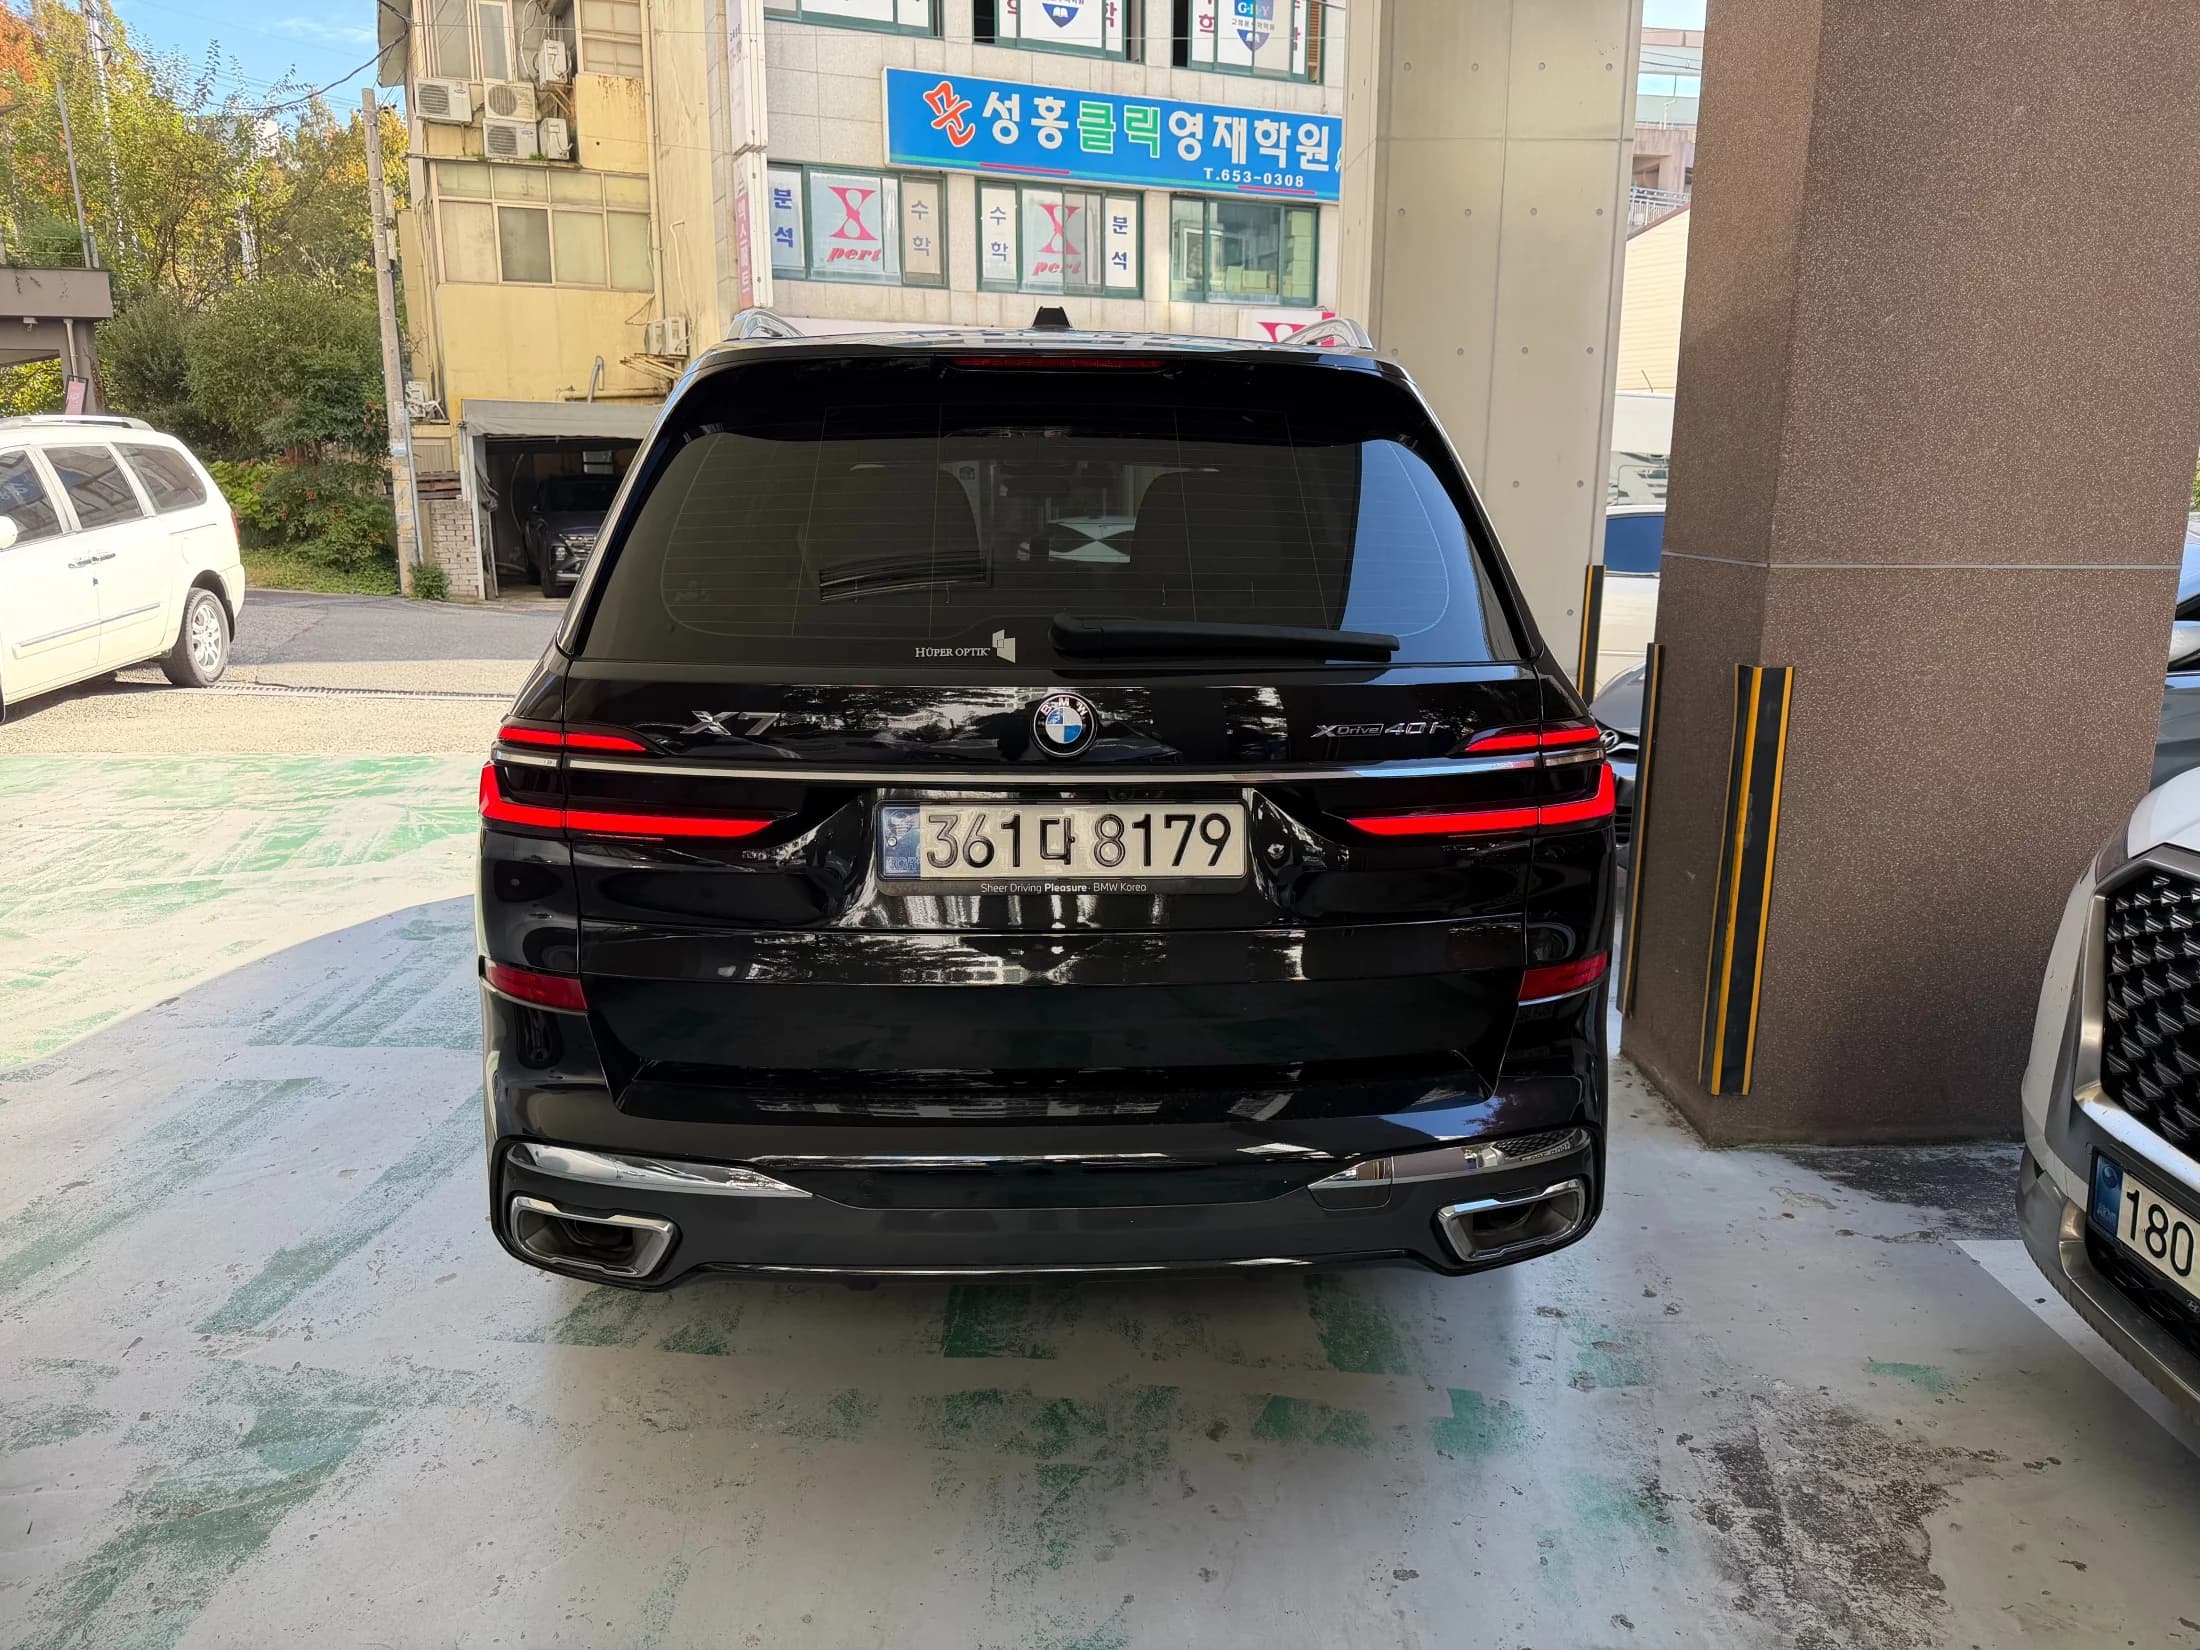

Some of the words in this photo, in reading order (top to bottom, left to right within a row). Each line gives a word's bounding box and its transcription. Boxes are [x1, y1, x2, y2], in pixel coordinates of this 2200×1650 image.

[914, 646, 954, 658] HÜPER
[1040, 696, 1088, 717] BMW
[679, 710, 782, 736] X7
[1093, 812, 1232, 868] 8179
[980, 883, 1008, 893] Sheer
[1010, 883, 1042, 894] Driving
[1093, 882, 1118, 892] BMW
[1120, 882, 1147, 892] Korea
[2126, 1189, 2195, 1277] 180
